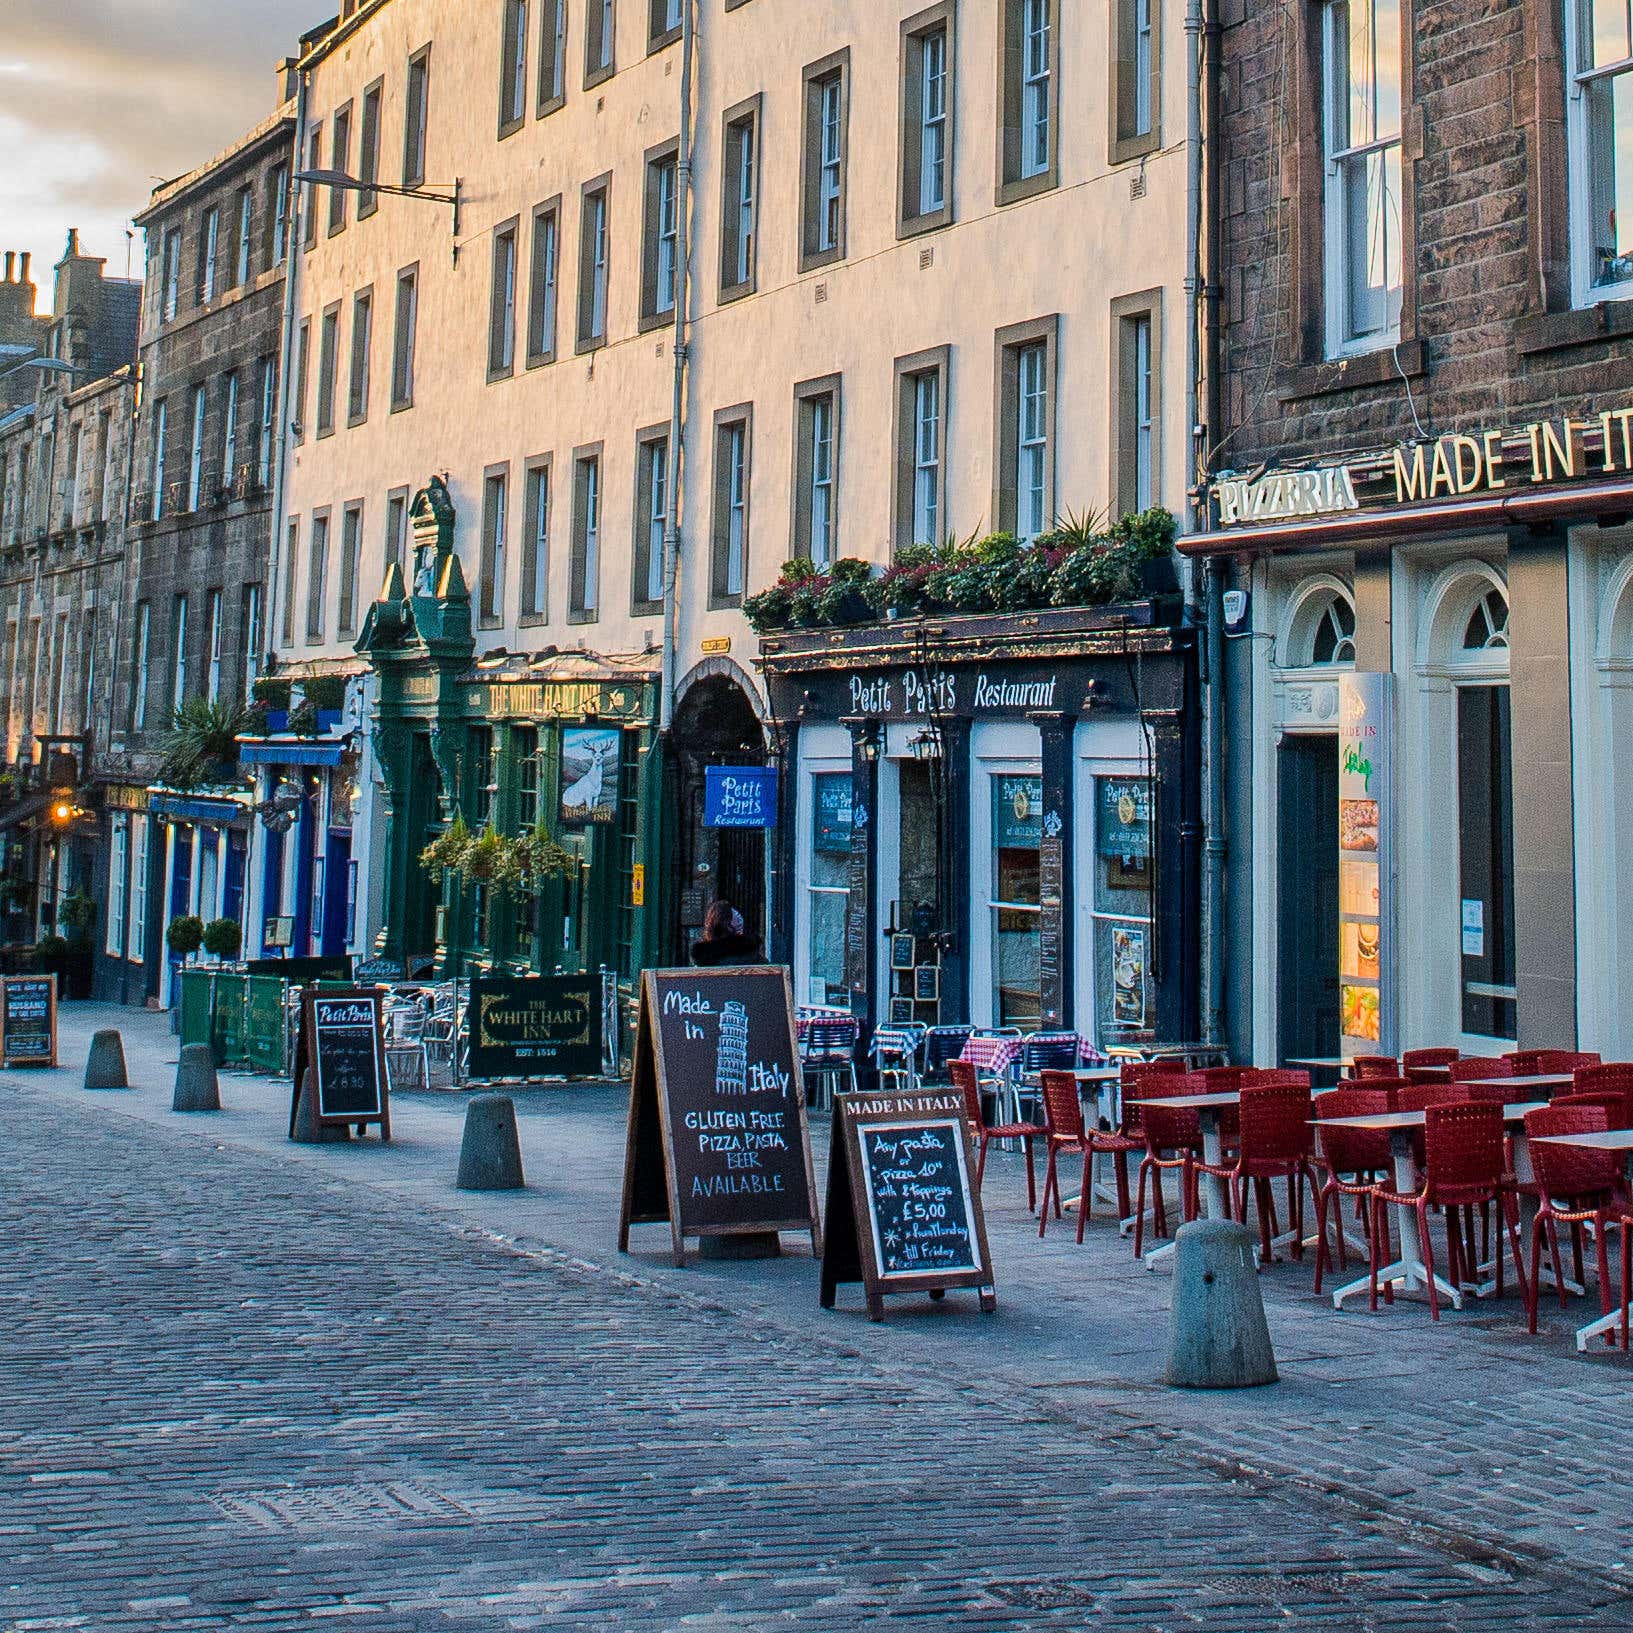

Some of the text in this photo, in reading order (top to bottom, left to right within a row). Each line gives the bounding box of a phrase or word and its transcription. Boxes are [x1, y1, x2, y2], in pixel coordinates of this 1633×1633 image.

[1217, 467, 1360, 525] PIZZERIA
[1392, 430, 1505, 504] MADE
[1526, 417, 1575, 483] IN
[489, 684, 509, 713] THE
[509, 684, 542, 713] WHITE
[544, 684, 578, 713] HART
[579, 684, 602, 714] INN
[849, 670, 1057, 714] Petit Paris Restaurant
[722, 776, 762, 799] Petit
[721, 795, 762, 816] Paris
[714, 814, 765, 826] Restaurant
[320, 1004, 347, 1023] Petit
[663, 990, 718, 1016] Made
[489, 1009, 583, 1025] WHITE HART
[523, 1025, 552, 1040] INN
[685, 1020, 705, 1041] in
[748, 1062, 789, 1098] Italy
[847, 1095, 963, 1116] MADE IN ITALY
[685, 1110, 785, 1131] GLUTEN FREE
[874, 1129, 945, 1160] Any pasta
[727, 1152, 763, 1169] BEER
[691, 1174, 785, 1198] AVAILABLE
[880, 1168, 917, 1186] pizza
[876, 1184, 897, 1197] with
[909, 1182, 953, 1202] toppings
[921, 1240, 955, 1260] Friday
